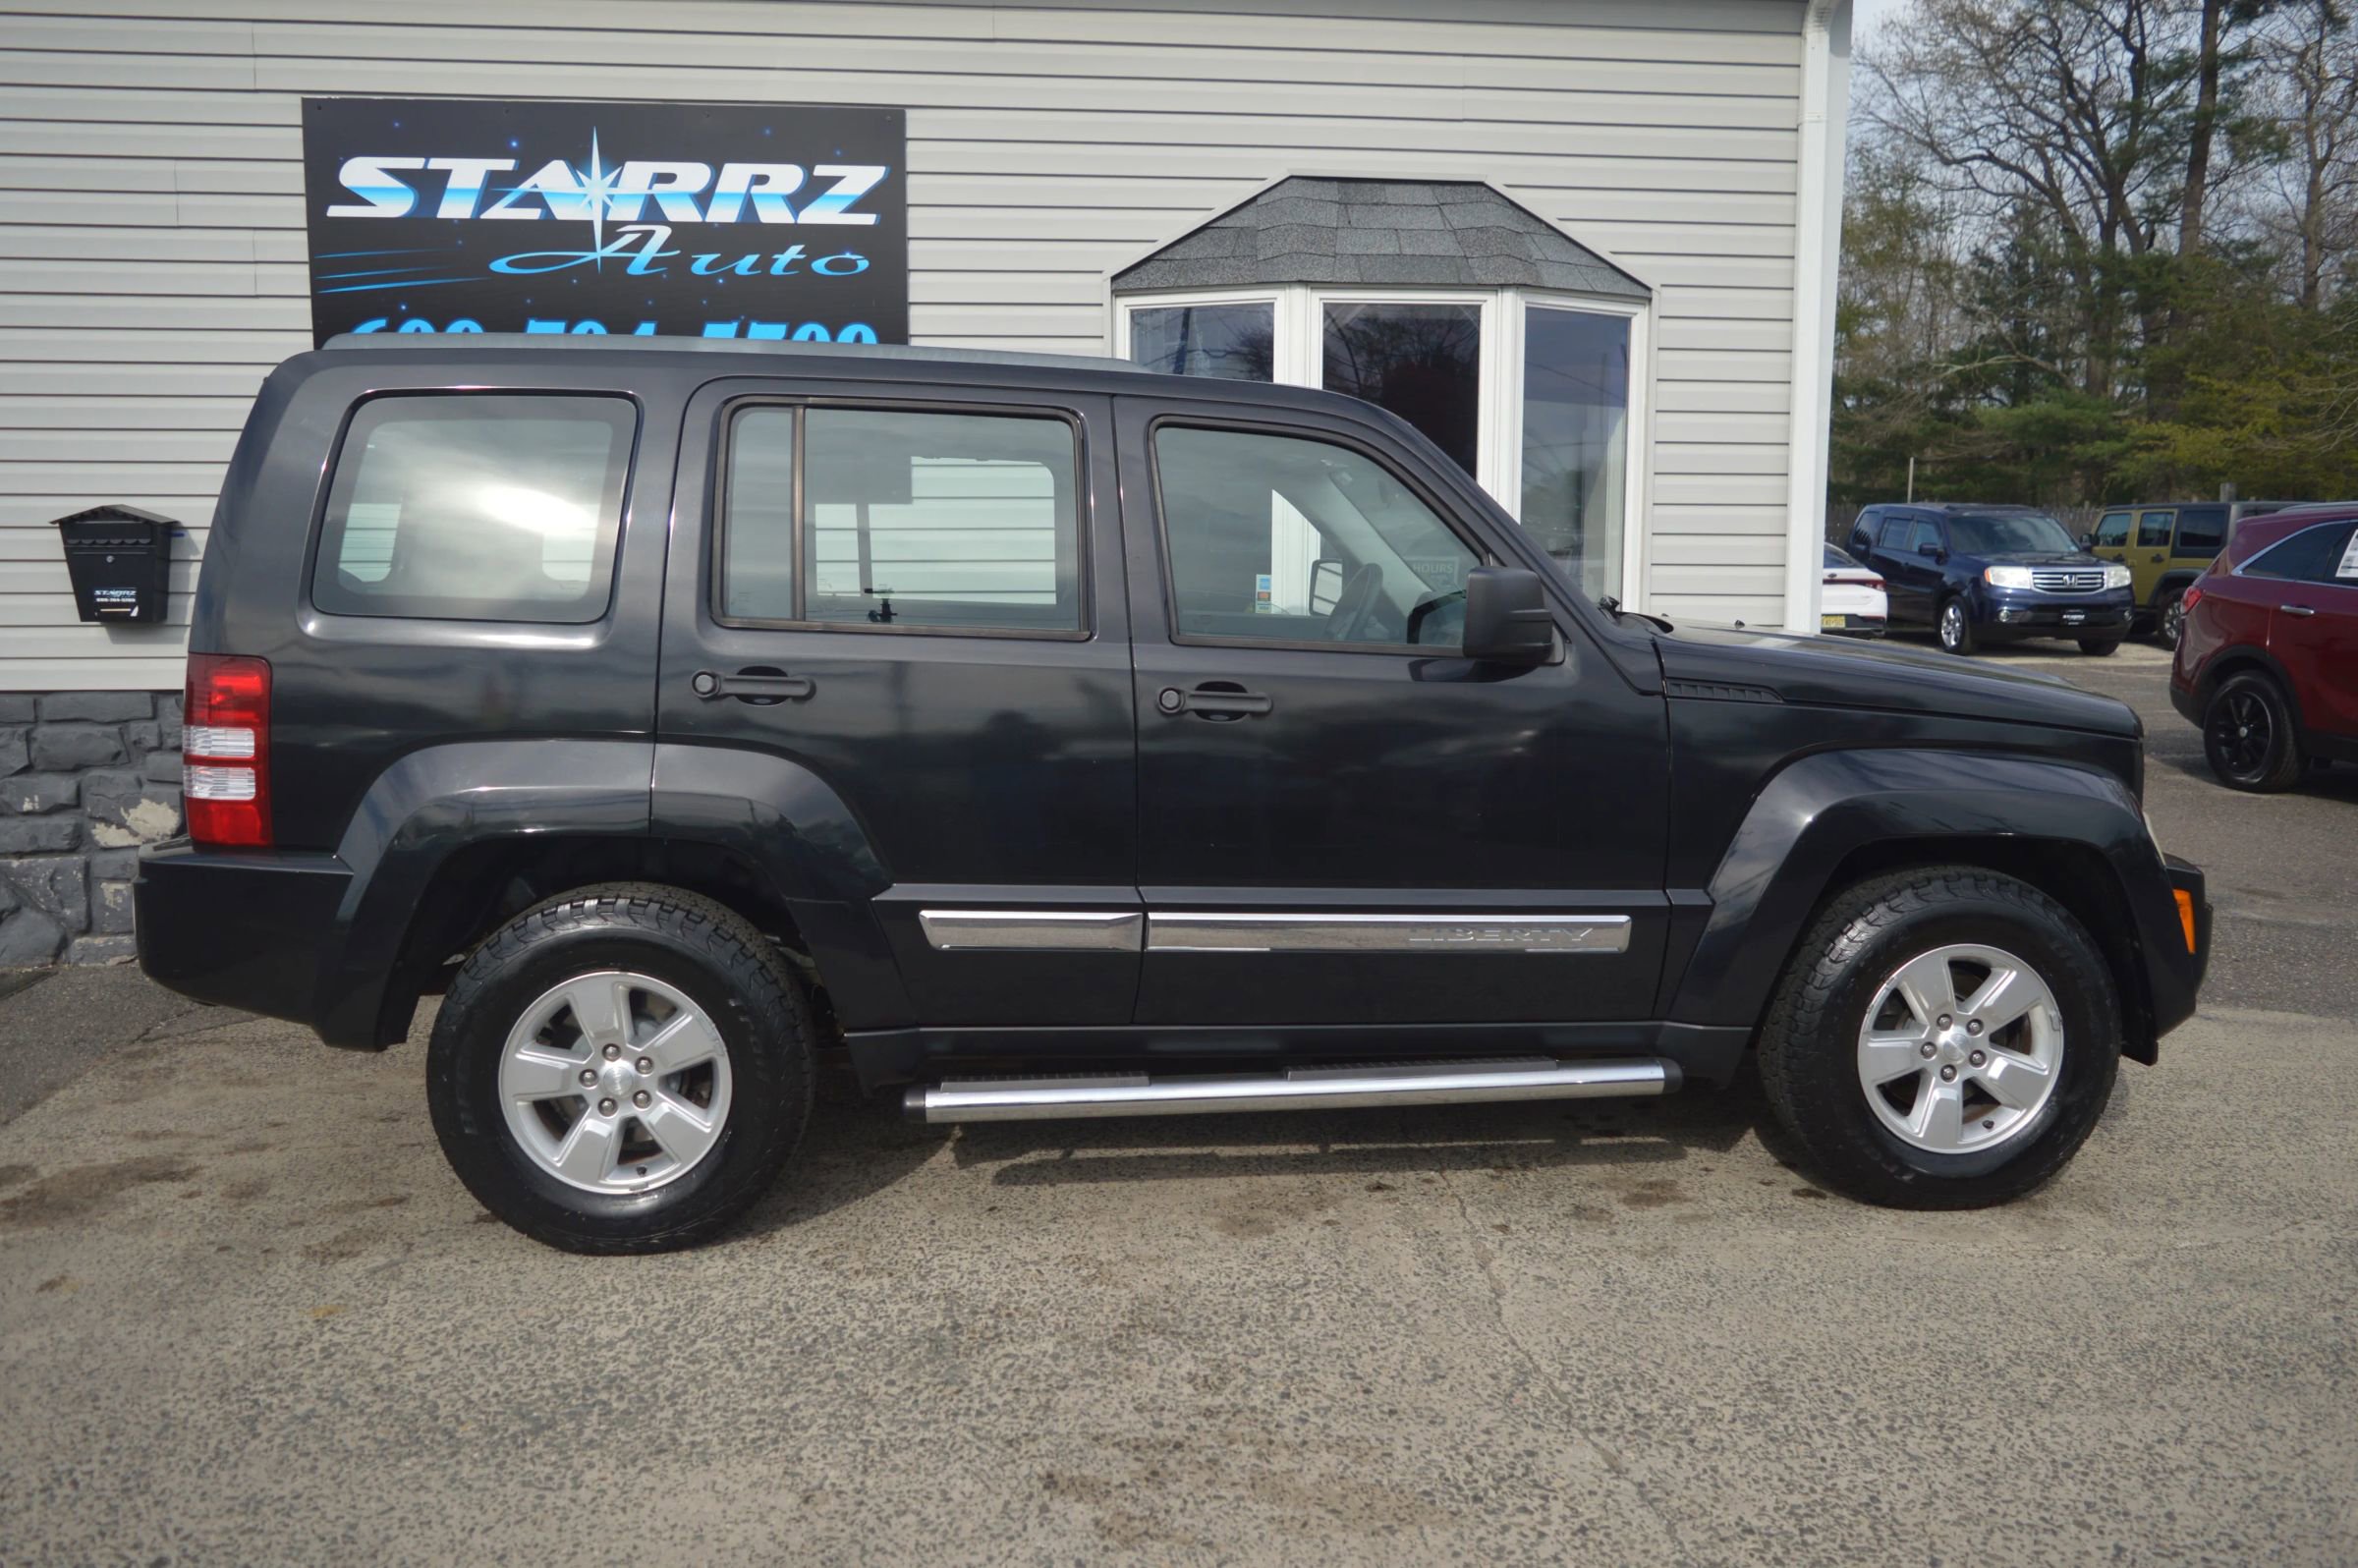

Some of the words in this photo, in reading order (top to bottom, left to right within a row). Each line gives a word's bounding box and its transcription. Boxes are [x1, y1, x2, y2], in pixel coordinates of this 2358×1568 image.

[326, 155, 890, 226] STARRZ
[488, 224, 870, 277] Auto
[1412, 562, 1454, 575] HOURS
